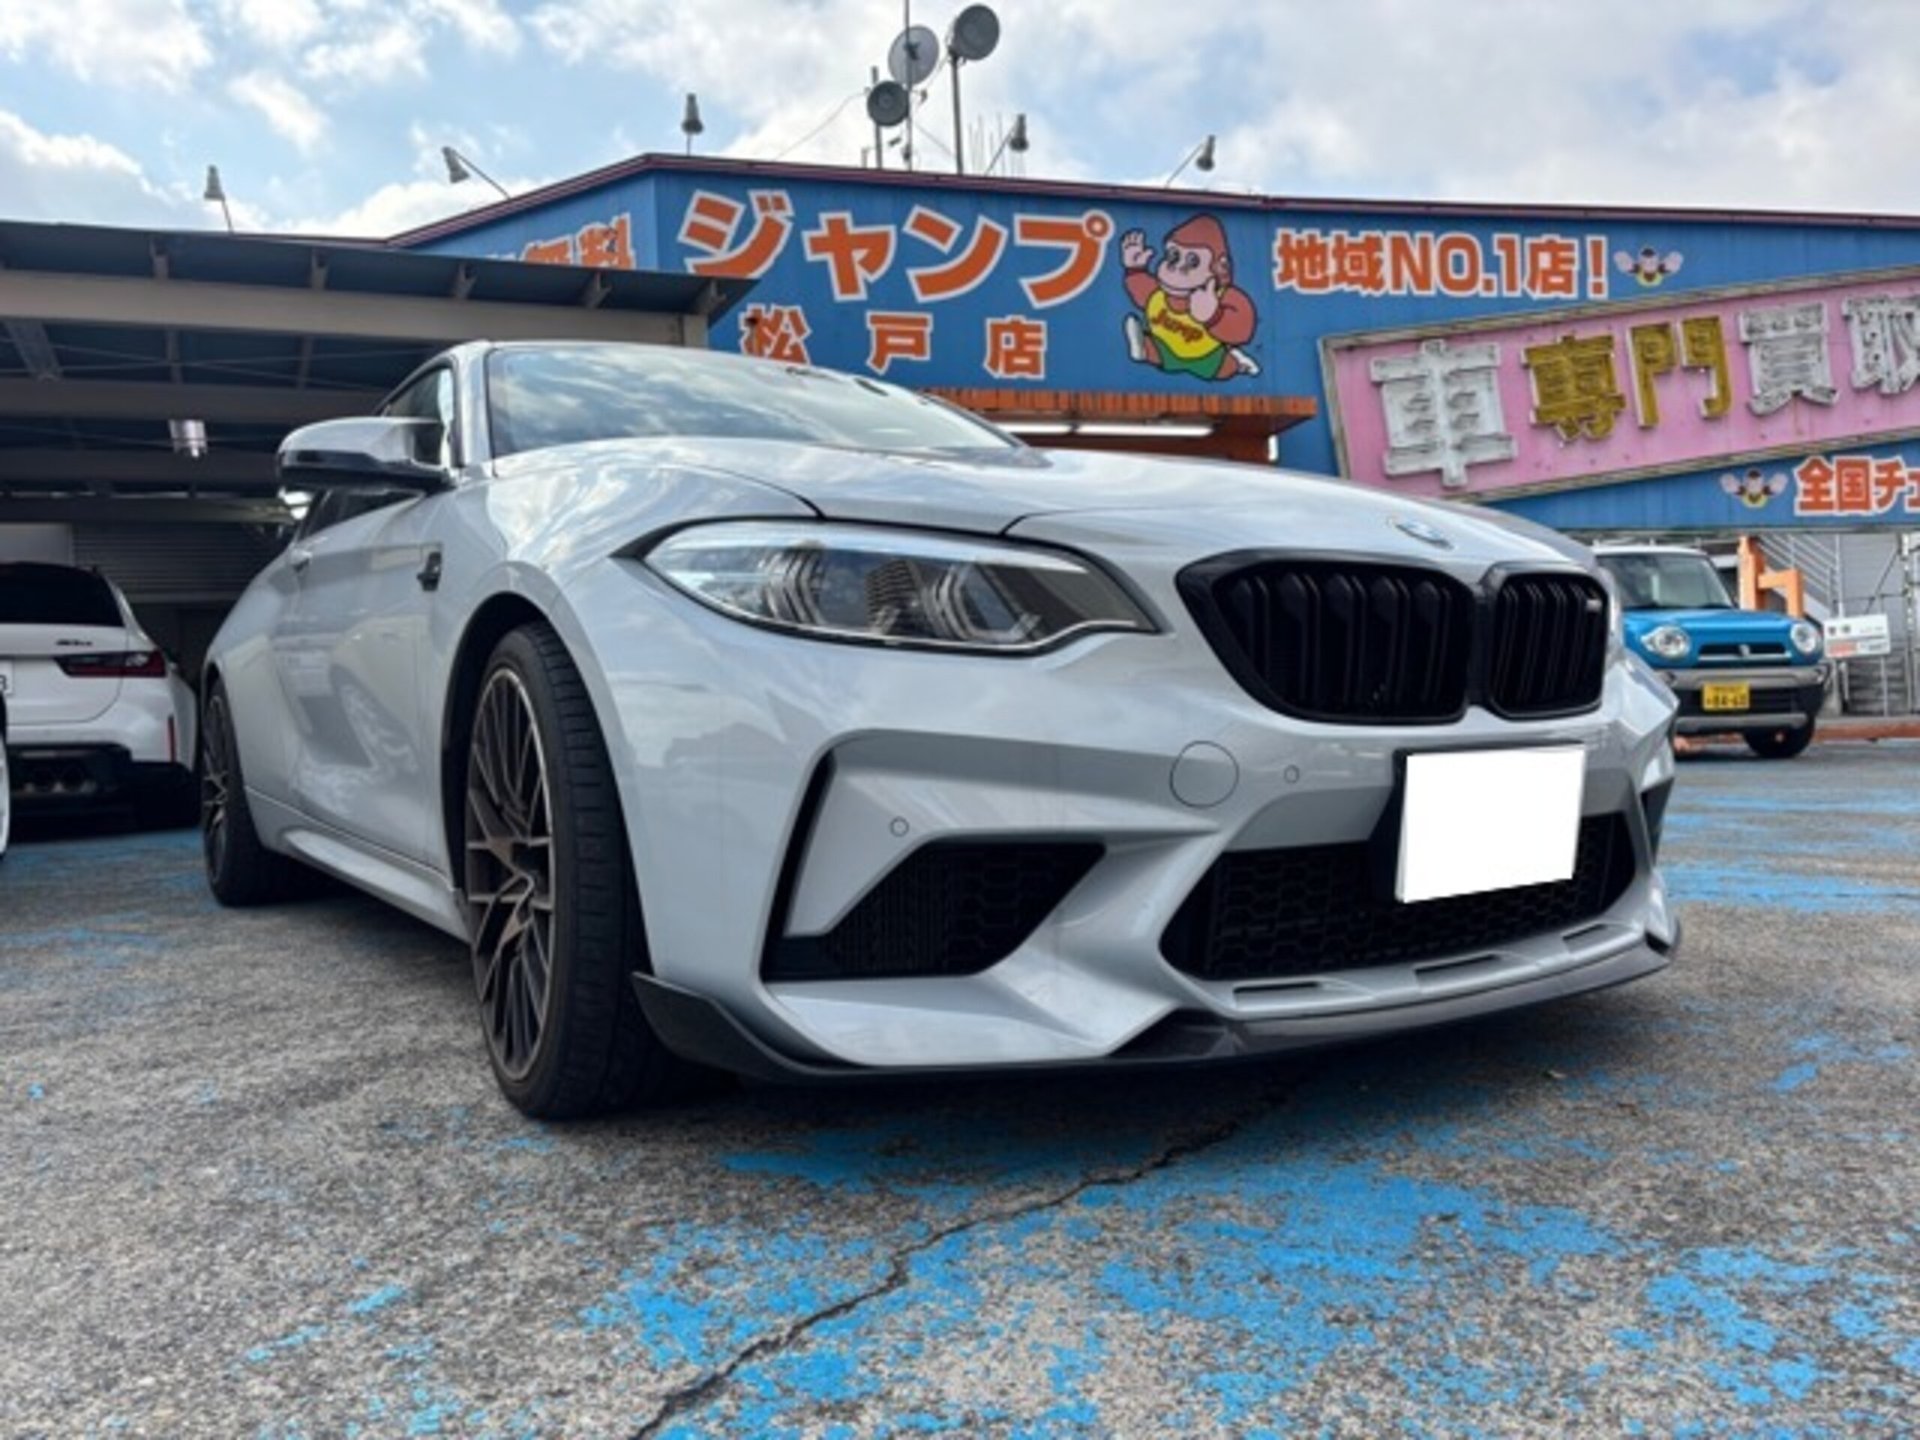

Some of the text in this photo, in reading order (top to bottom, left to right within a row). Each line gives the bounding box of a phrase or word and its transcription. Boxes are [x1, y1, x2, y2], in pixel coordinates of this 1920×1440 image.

[678, 189, 1115, 309] ジャンプ
[1273, 226, 1609, 299] 地域NO.1店!
[739, 304, 1048, 379] 松戸店
